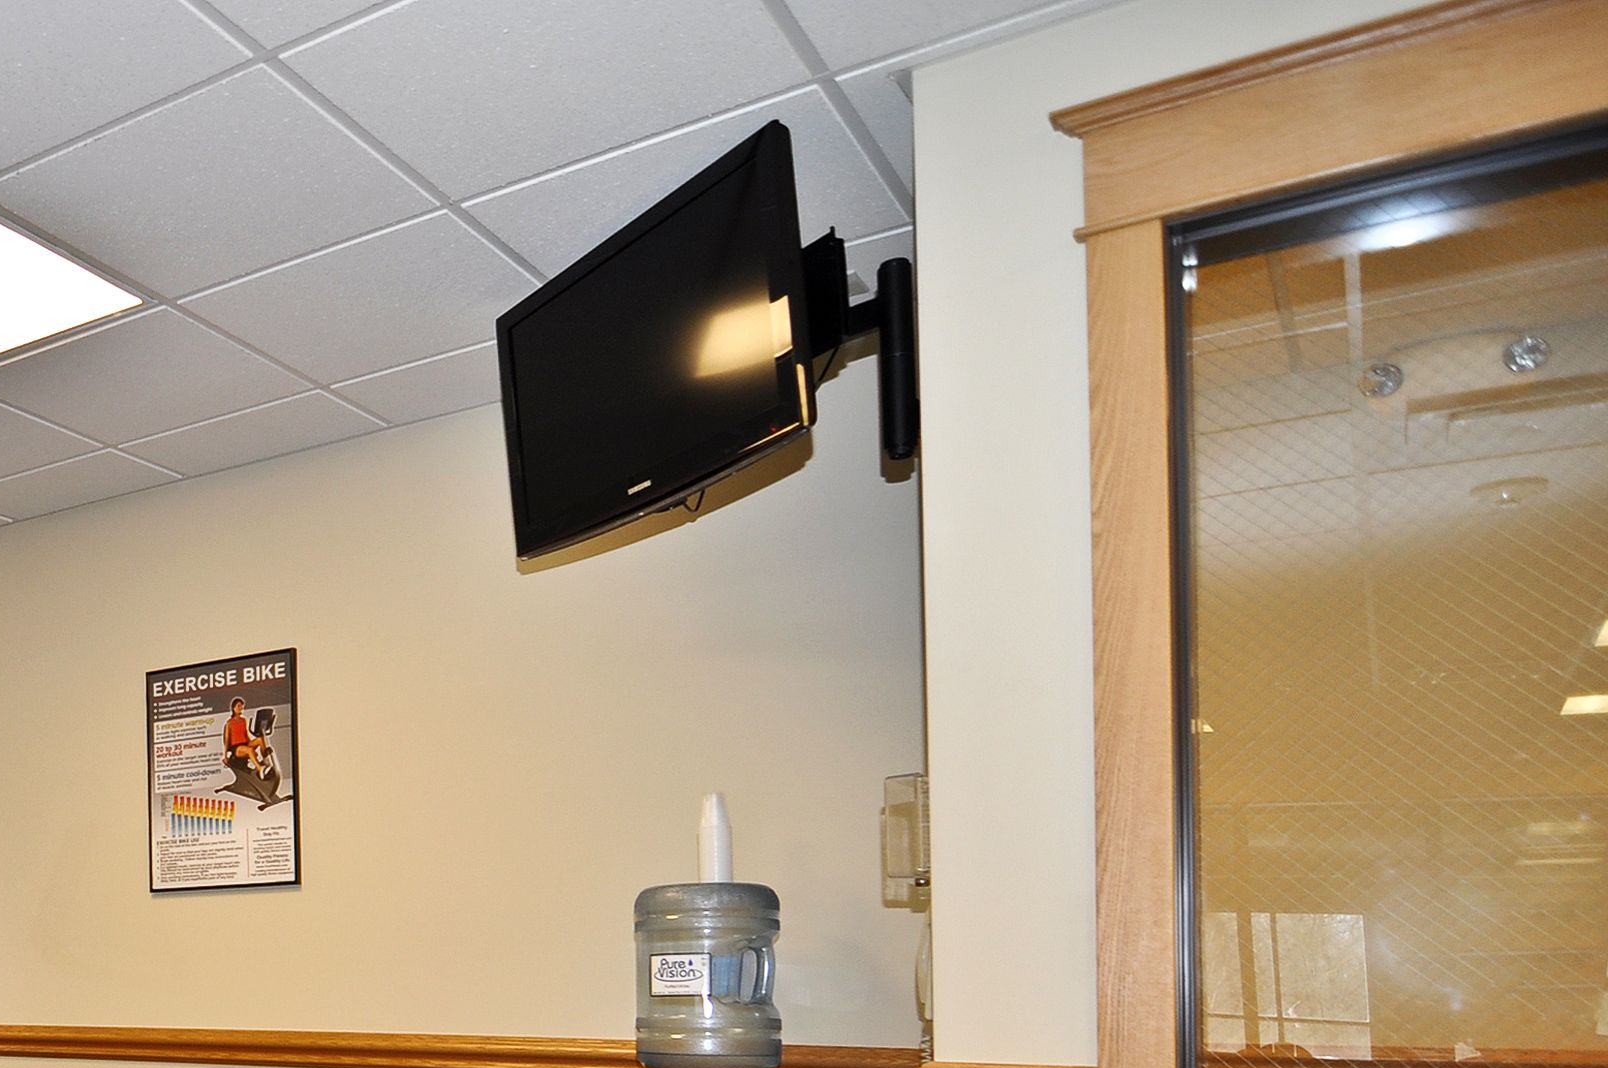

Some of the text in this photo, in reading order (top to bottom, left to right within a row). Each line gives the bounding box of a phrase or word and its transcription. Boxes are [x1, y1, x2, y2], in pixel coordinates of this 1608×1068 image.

[153, 662, 286, 697] EXERCISE BIKE
[183, 741, 207, 750] minute
[156, 750, 183, 758] workout
[186, 769, 221, 779] cool-down
[660, 958, 686, 970] Pure
[657, 967, 696, 978] Vision
